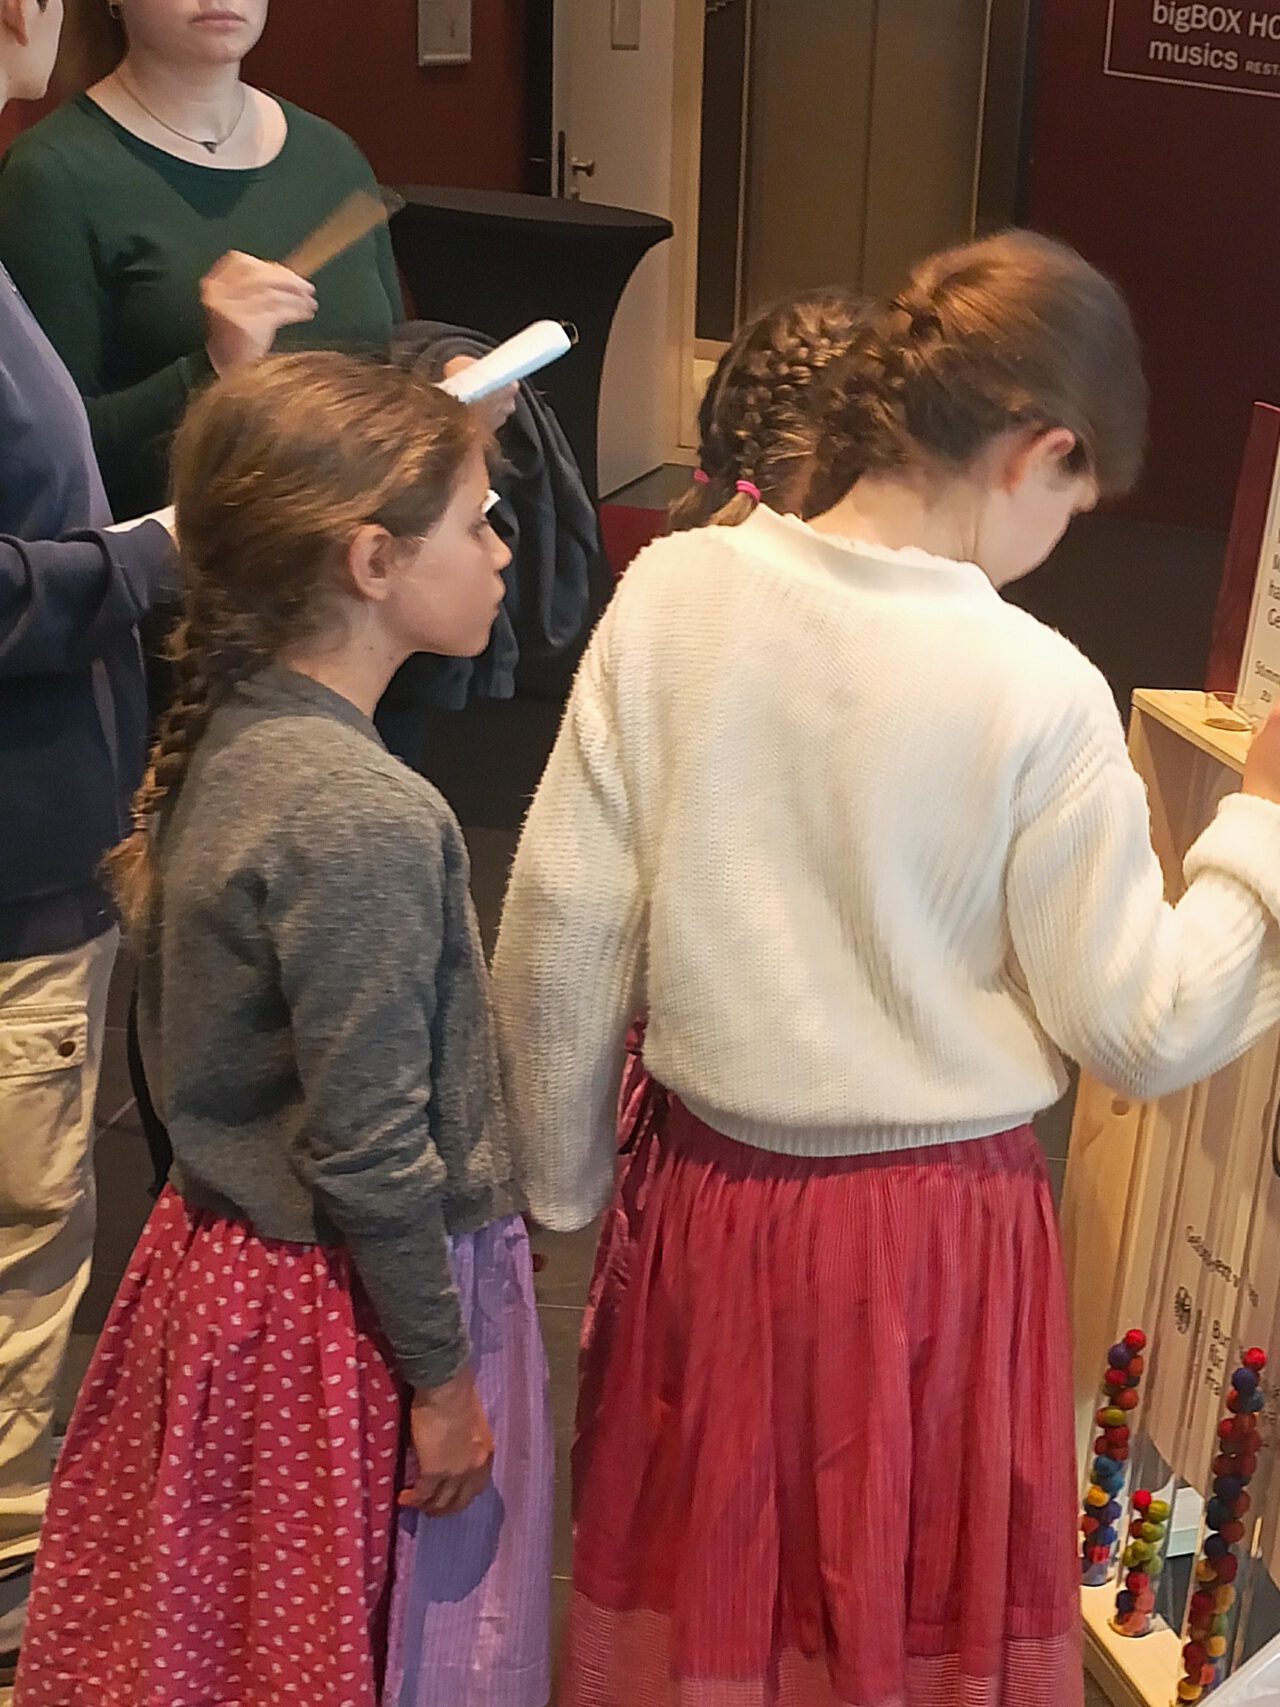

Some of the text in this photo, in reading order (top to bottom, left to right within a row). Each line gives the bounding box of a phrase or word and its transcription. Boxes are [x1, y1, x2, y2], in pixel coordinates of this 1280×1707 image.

[1152, 0, 1242, 34] bigBOX
[1149, 40, 1239, 71] musics
[1261, 690, 1273, 703] zu
